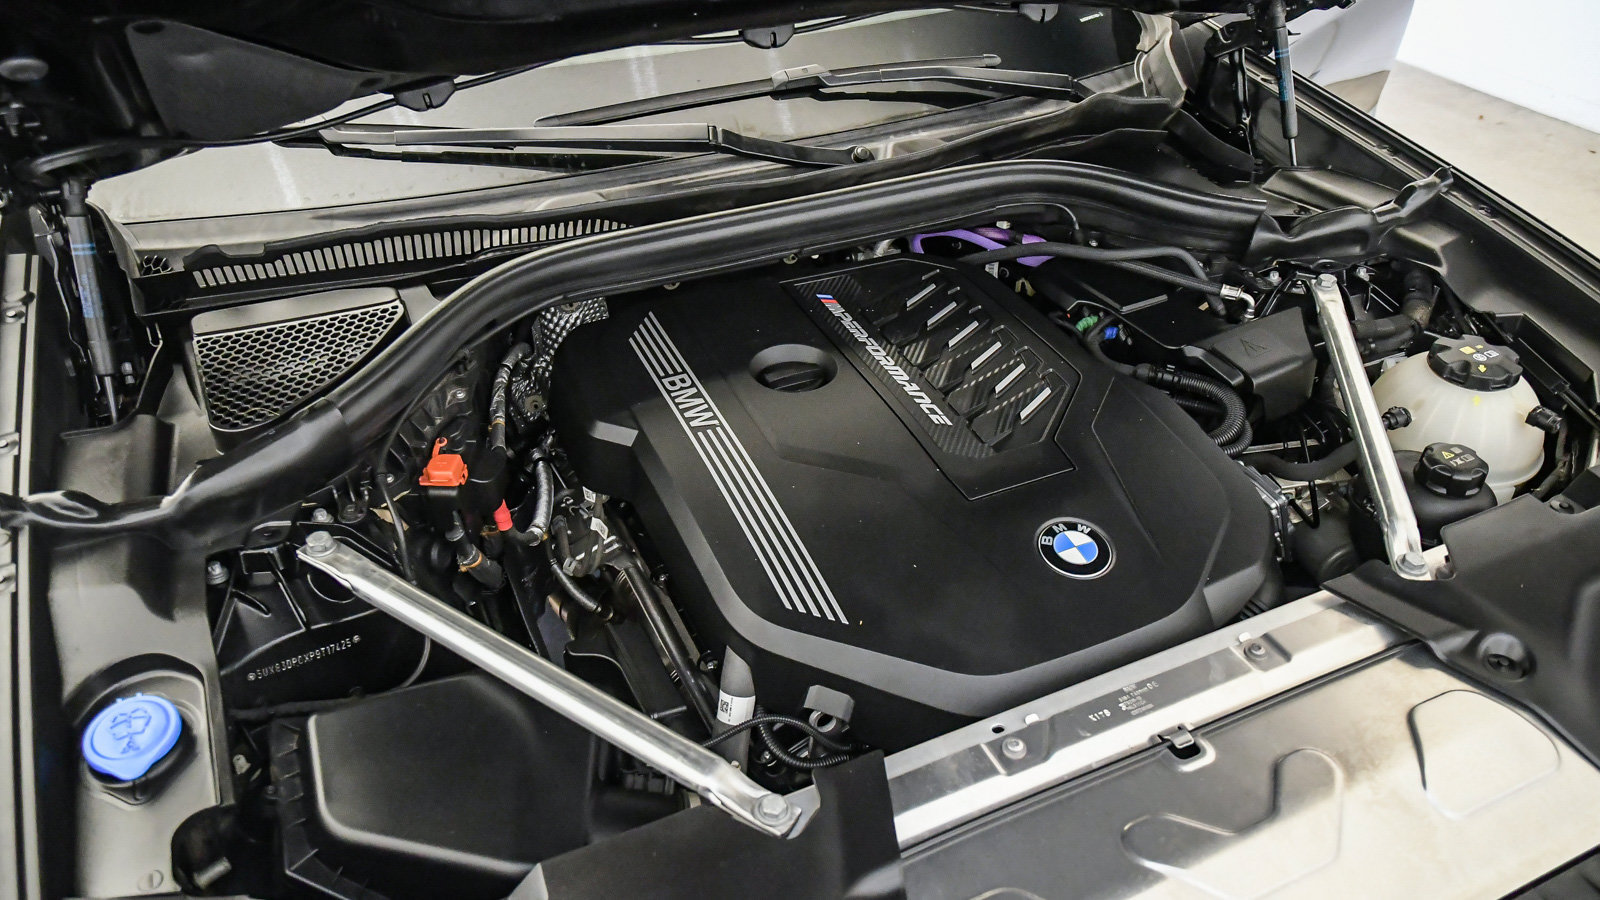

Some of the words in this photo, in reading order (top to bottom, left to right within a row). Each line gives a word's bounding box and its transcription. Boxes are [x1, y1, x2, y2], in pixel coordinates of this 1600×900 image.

[835, 311, 953, 426] PERFORMANCE
[661, 372, 720, 427] BMW
[1041, 523, 1092, 546] BMW
